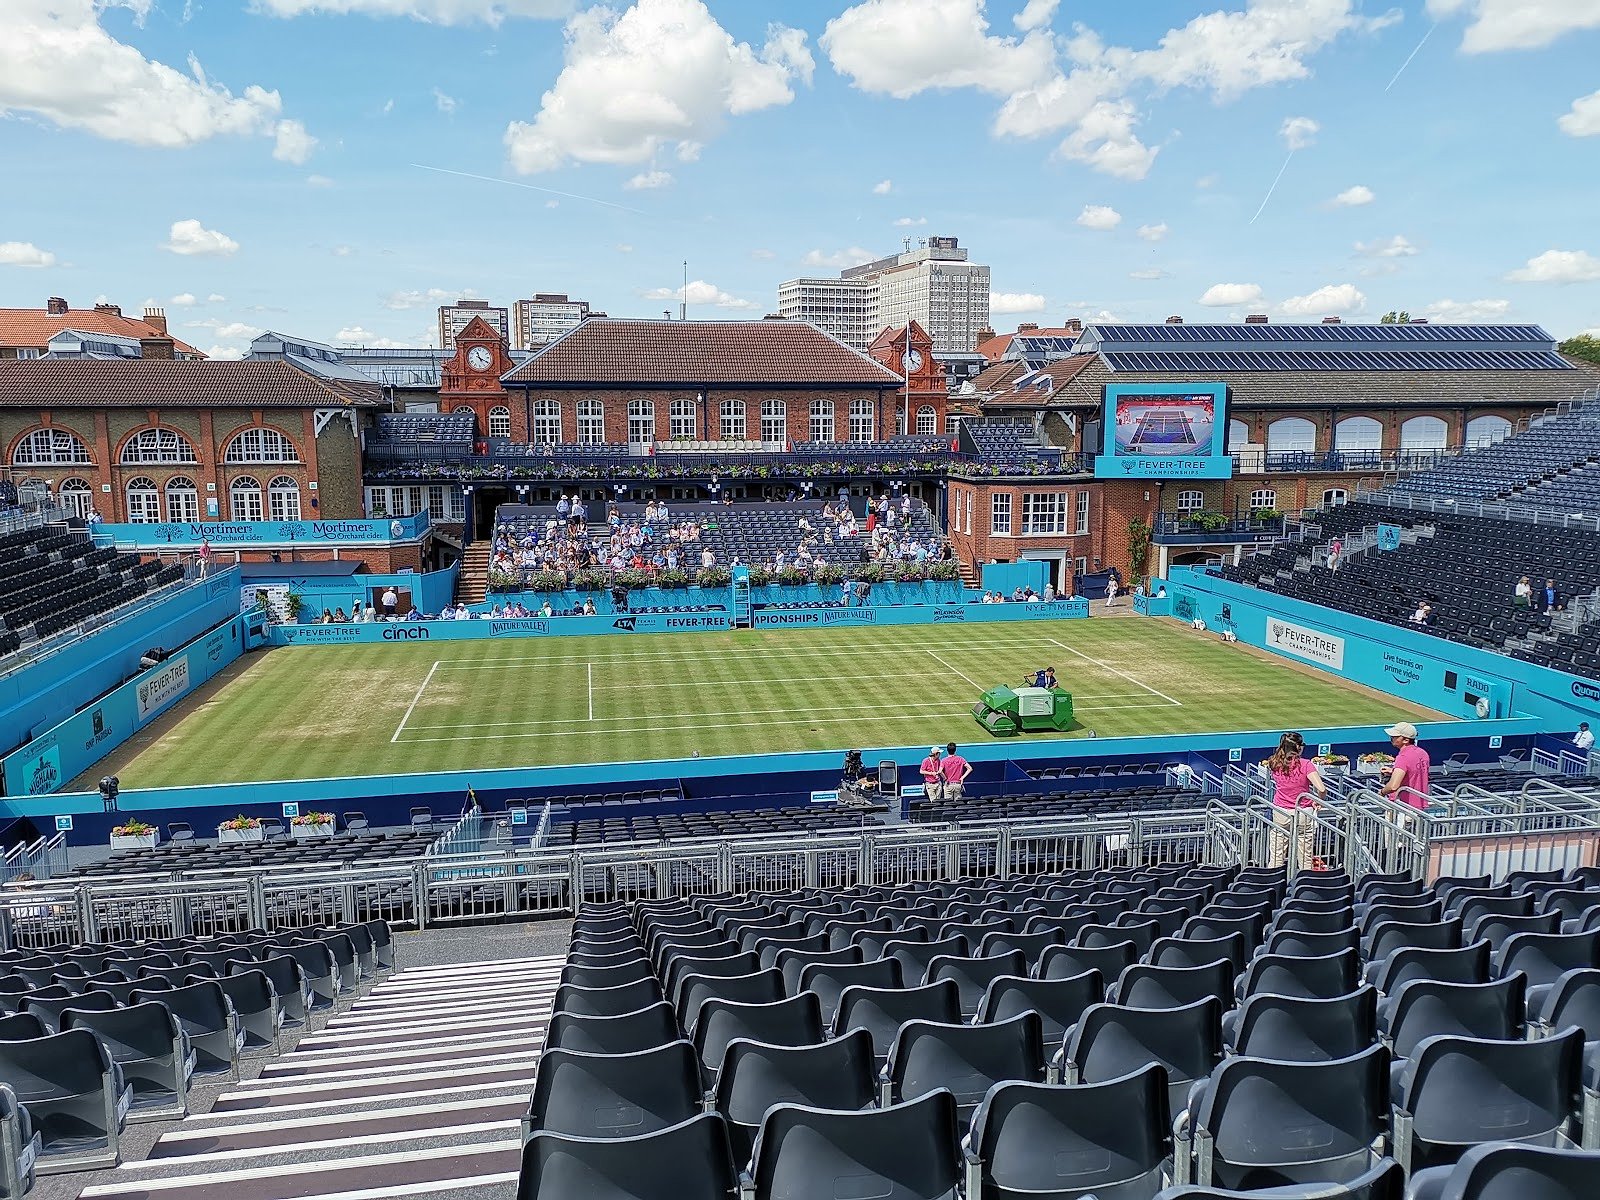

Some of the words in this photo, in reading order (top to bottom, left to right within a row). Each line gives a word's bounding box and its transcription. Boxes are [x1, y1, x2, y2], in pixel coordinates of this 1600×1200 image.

[1139, 460, 1205, 468] FEVER-TREE
[190, 523, 252, 538] Mortimers
[312, 522, 373, 537] Mortimers
[1026, 603, 1088, 611] NYETIMBER
[667, 618, 724, 627] FEVER-TREE
[824, 612, 850, 622] NATURE
[851, 610, 874, 620] VALLEY
[383, 624, 429, 639] cinch
[492, 621, 520, 634] NATURE
[521, 621, 547, 632] VALLEY
[618, 619, 634, 630] LTA
[300, 628, 360, 636] FEVER-TREE
[1286, 628, 1336, 653] FEVER-TREE
[1289, 642, 1330, 660] CHAMPIONSHIPS
[1384, 652, 1394, 662] Live
[1396, 656, 1414, 668] tennis
[150, 662, 186, 696] FEVER-TREE
[1385, 664, 1402, 676] prime
[1403, 669, 1419, 680] video
[1467, 678, 1489, 692] RADO
[86, 738, 94, 750] BNP
[29, 767, 57, 795] HIGHLAND
